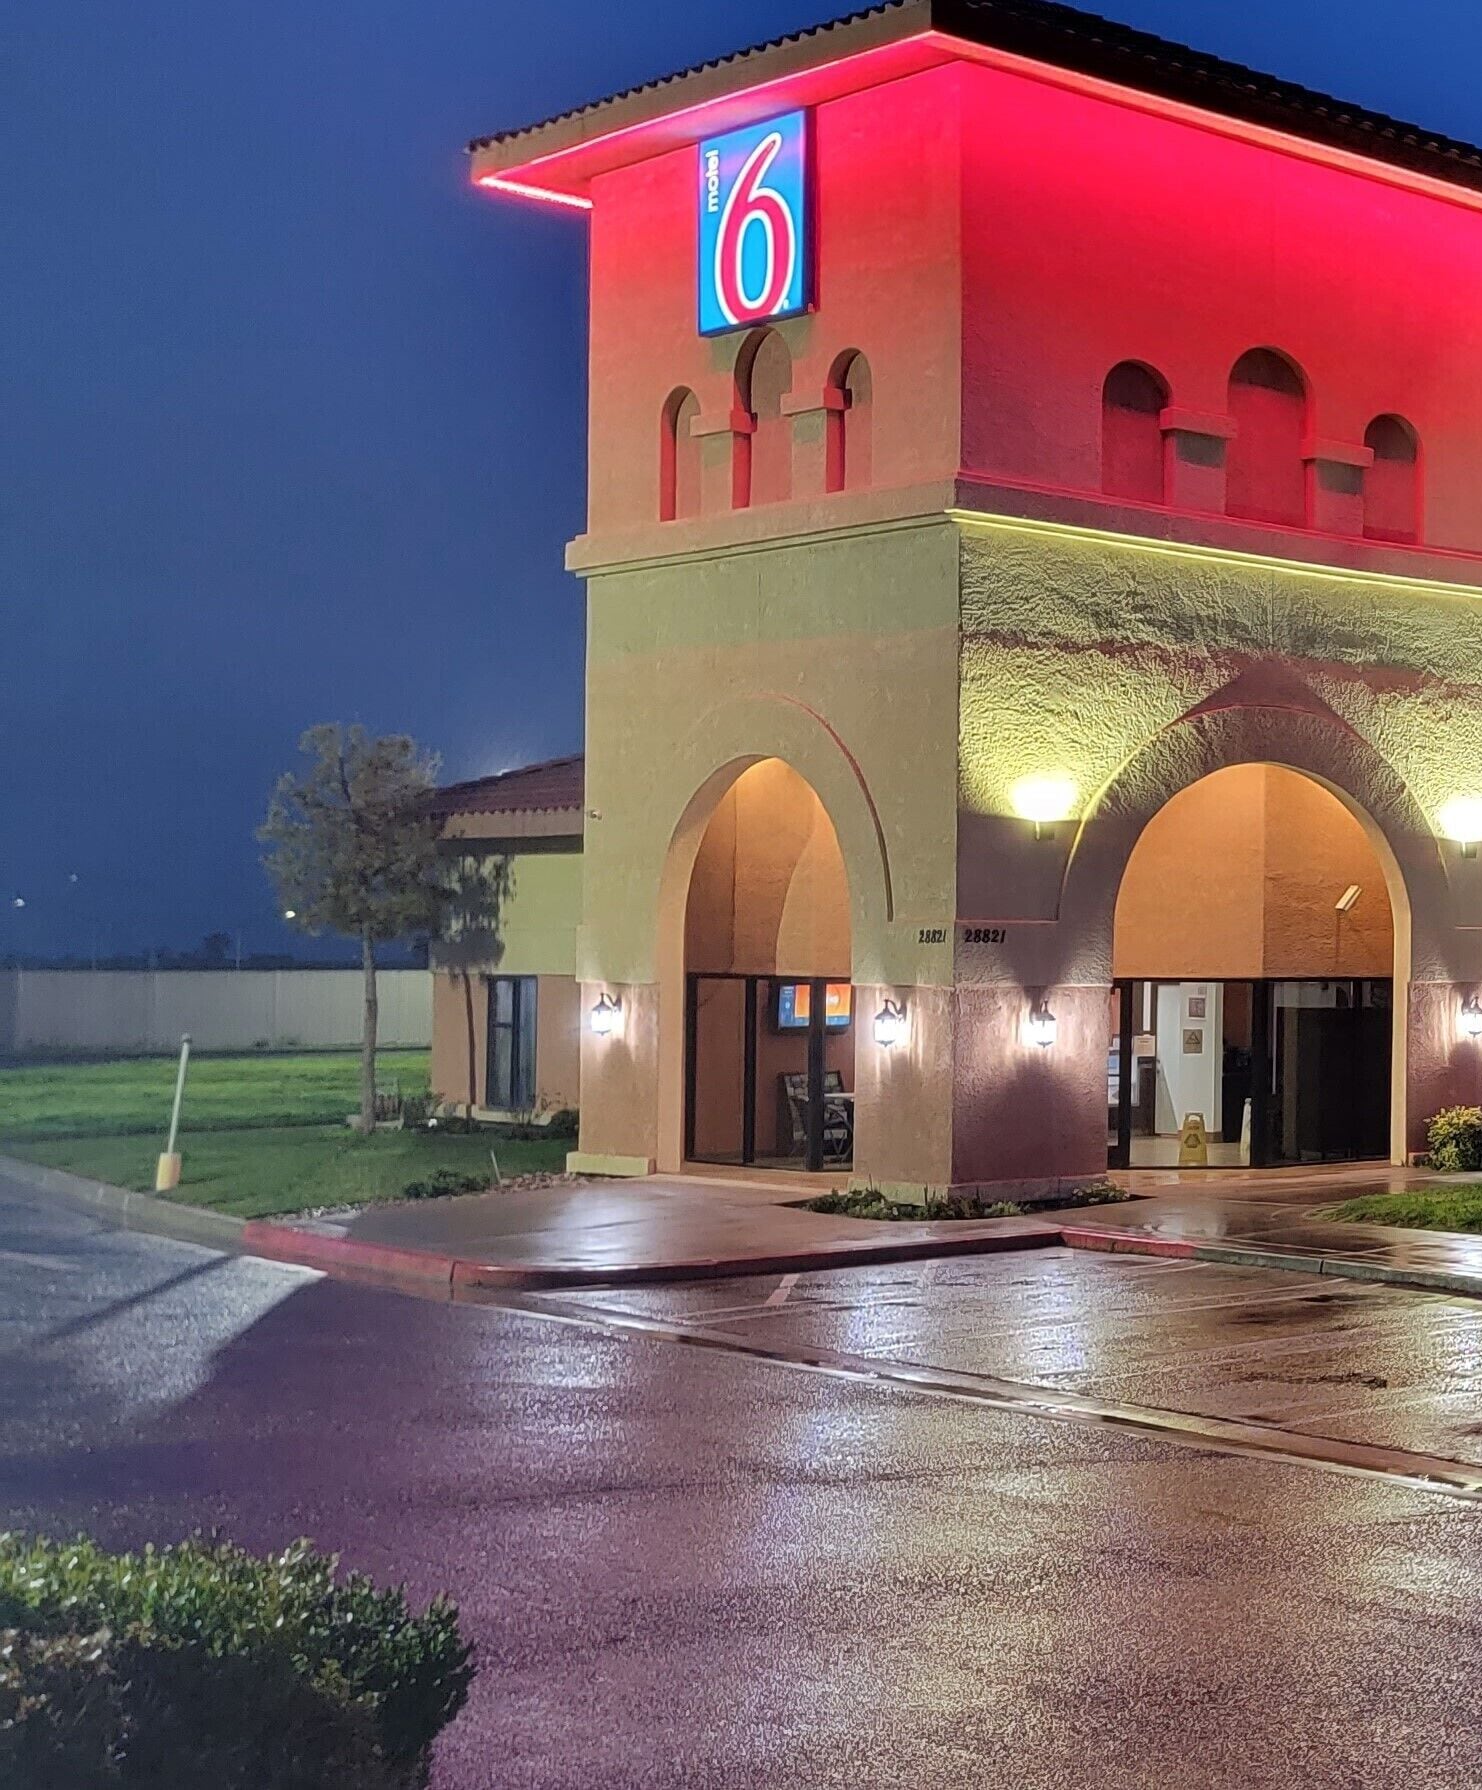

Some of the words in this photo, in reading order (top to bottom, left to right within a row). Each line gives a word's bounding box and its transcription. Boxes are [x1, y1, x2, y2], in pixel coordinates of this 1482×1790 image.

[705, 149, 719, 213] motel
[715, 132, 795, 324] 6
[918, 929, 947, 943] 28821
[964, 928, 1006, 943] 28821
